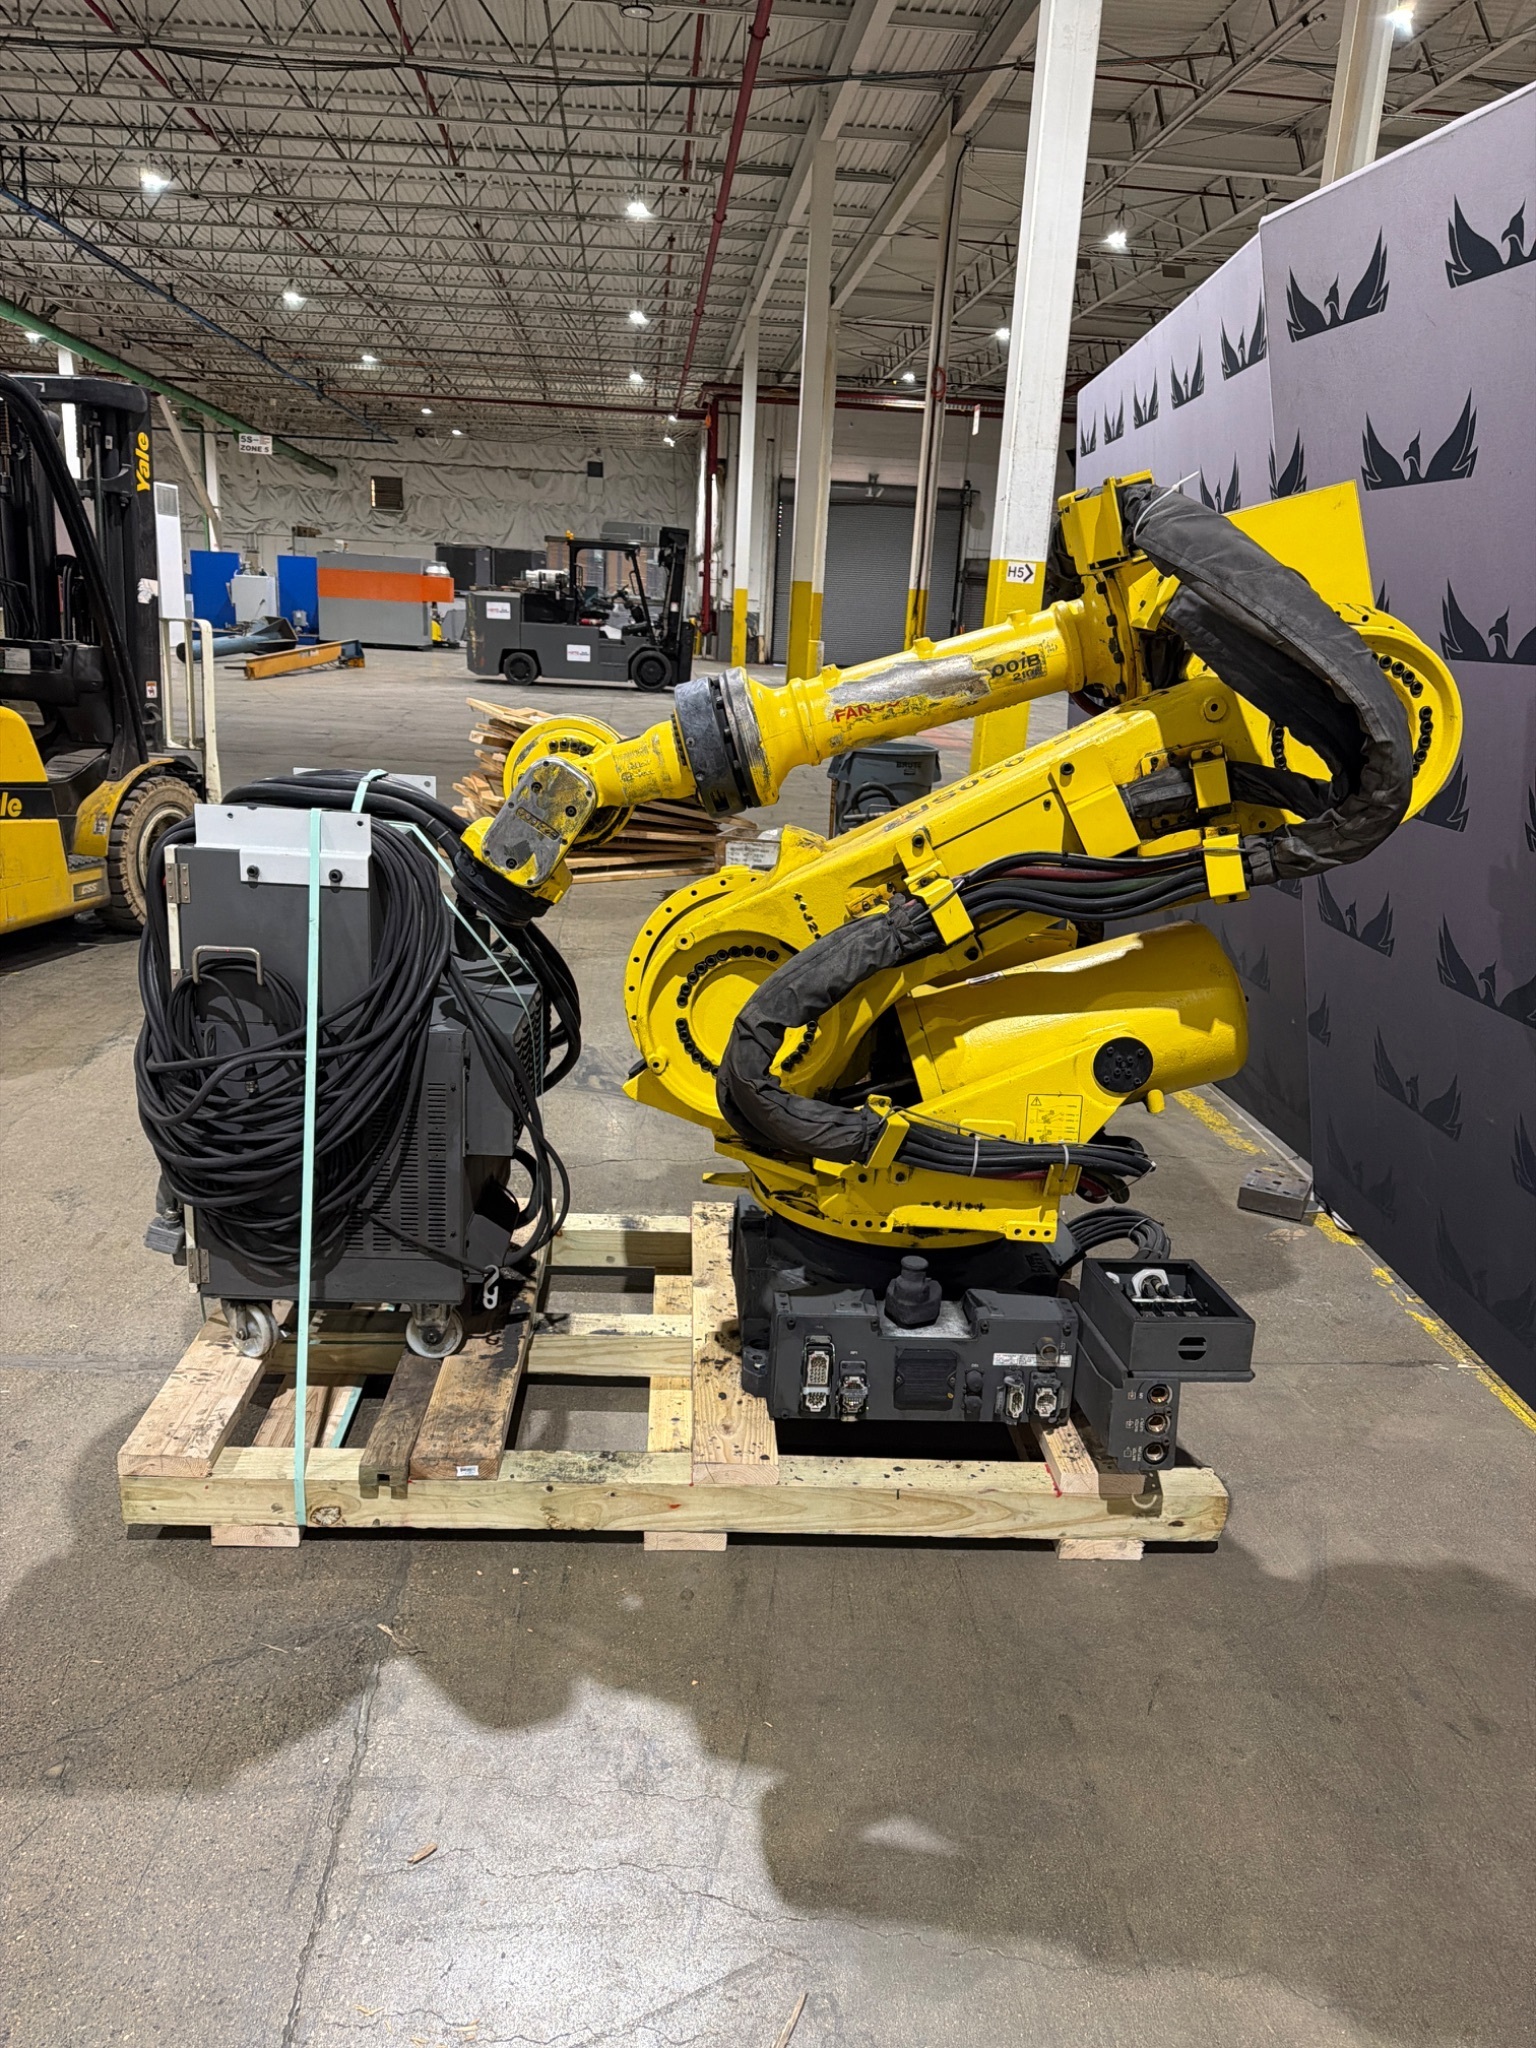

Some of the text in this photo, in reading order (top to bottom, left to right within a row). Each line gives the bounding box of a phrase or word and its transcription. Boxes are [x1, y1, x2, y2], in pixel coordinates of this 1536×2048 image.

[135, 432, 150, 491] Yale
[1007, 565, 1025, 578] H5
[835, 700, 901, 723] FAN
[0, 791, 23, 817] le
